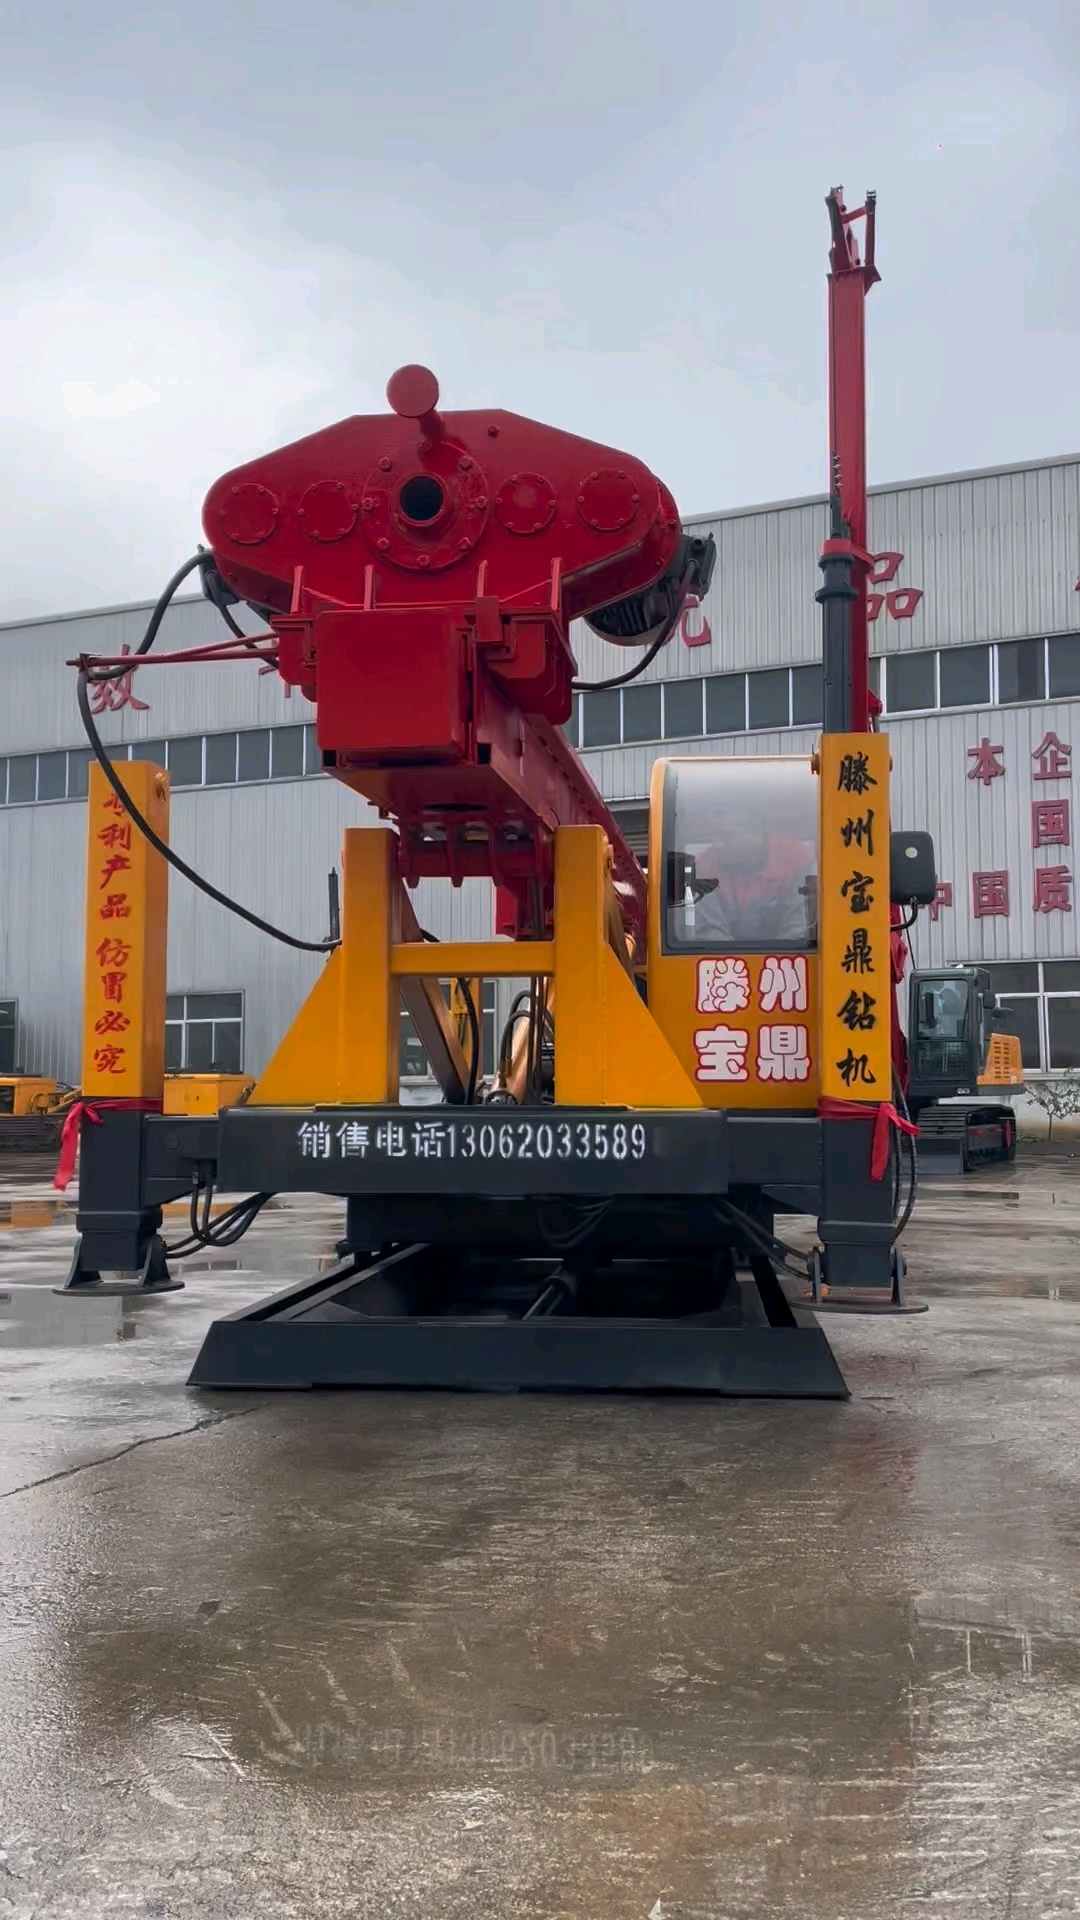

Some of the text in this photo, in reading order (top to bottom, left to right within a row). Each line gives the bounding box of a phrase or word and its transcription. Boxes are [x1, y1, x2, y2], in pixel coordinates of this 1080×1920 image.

[836, 751, 878, 1087] 滕州宝鼎钻机
[695, 955, 809, 1014] 滕州
[693, 1023, 812, 1082] 宝鼎
[297, 1120, 646, 1160] 销售电话13062033589
